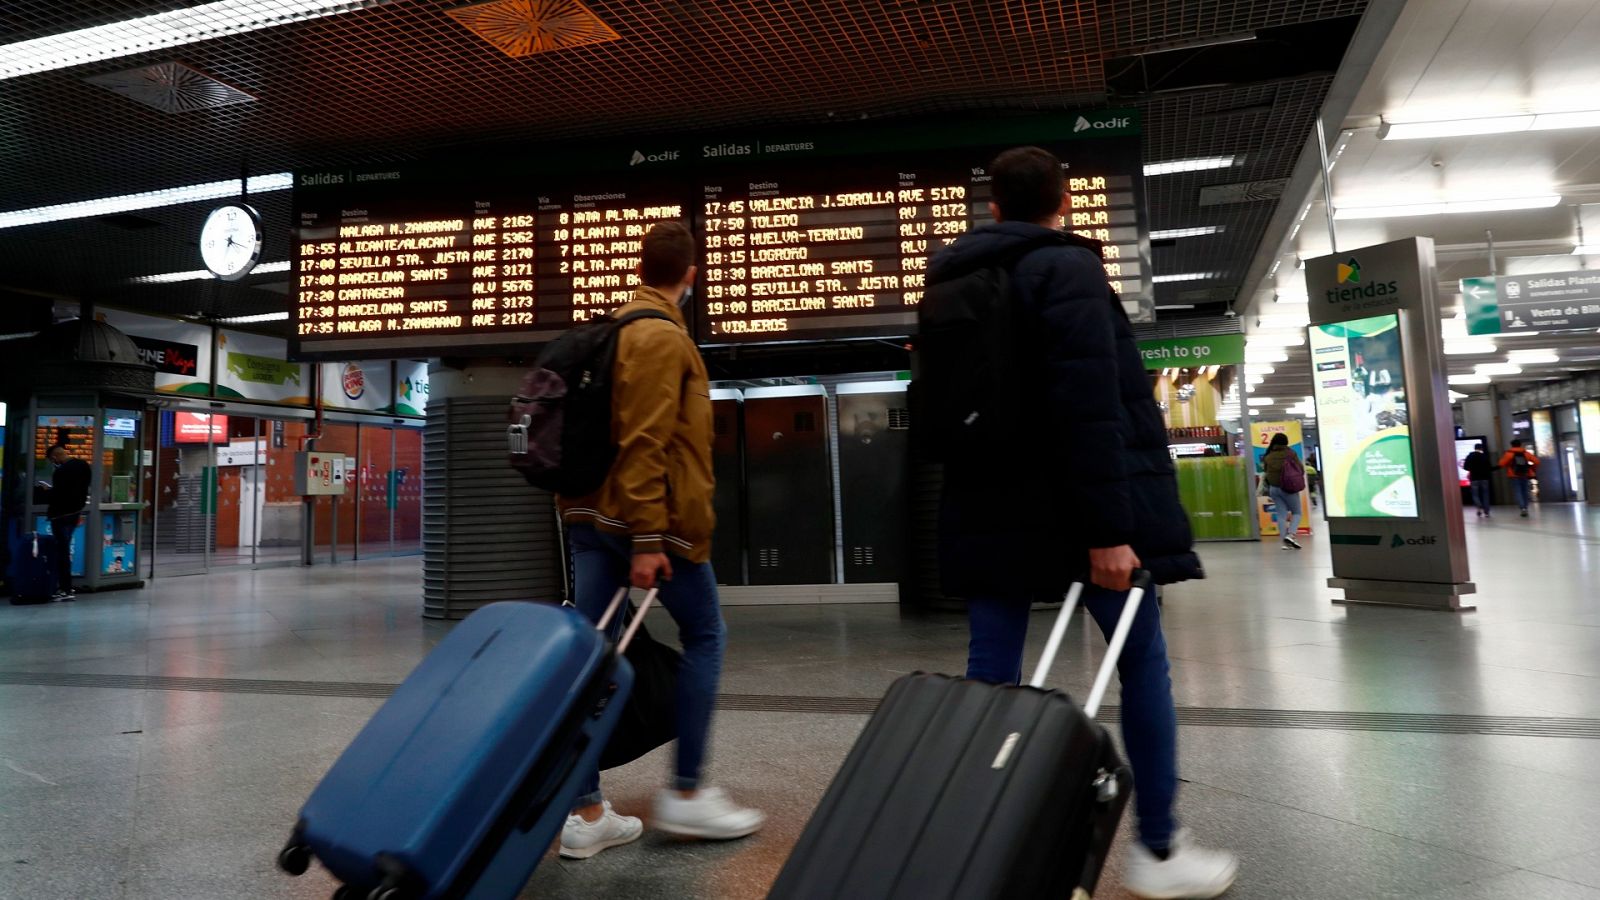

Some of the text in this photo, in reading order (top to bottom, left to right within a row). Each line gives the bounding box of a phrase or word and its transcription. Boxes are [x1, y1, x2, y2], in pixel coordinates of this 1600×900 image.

[1093, 117, 1131, 129] adif
[647, 151, 680, 162] adif
[703, 142, 815, 158] Salidas DEPARTURES
[301, 171, 401, 186] Salidas DEPARTURES
[898, 172, 916, 180] Tren
[704, 185, 722, 193] Hora
[749, 182, 779, 190] Destino
[1070, 177, 1106, 191] BAJA
[573, 192, 626, 202] Observaciones
[898, 186, 966, 202] AVE 5170
[1071, 194, 1107, 208] BAJA
[705, 201, 744, 215] 17:45
[749, 191, 894, 212] VALENCIA J.SOROLLA
[899, 203, 967, 220] AV 8172
[1072, 211, 1109, 226] BAJA
[473, 215, 533, 230] AVE 2162
[705, 217, 745, 232] 17:50
[750, 214, 798, 229] TOLEDO
[900, 220, 967, 237] ALV 2384
[473, 231, 533, 246] AVE 5362
[554, 230, 569, 242] 10
[573, 226, 620, 240] PLANTA
[750, 226, 863, 246] HUELVA-TERMINO
[706, 234, 745, 248] 18:05
[901, 239, 927, 253] ALV
[300, 243, 336, 256] 16:55
[473, 248, 533, 262] AVE 2170
[560, 245, 569, 256] 7
[300, 259, 336, 271] 17:00
[339, 251, 470, 269] SEVILLA STA. JUSTA
[706, 251, 745, 265] 18:15
[901, 257, 928, 270] AVE
[472, 263, 533, 278] AVE 3171
[559, 262, 569, 273] 2
[706, 267, 746, 282] 18:30
[751, 260, 873, 279] BARCELONA SANTS
[300, 274, 335, 287] 17:00
[339, 268, 448, 285] BARCELONA SANTS
[573, 275, 620, 289] PLANTA
[903, 273, 926, 288] AVE
[1528, 278, 1566, 289] Salidas
[472, 280, 533, 294] ALV 5676
[707, 284, 747, 298] 19:00
[751, 276, 899, 296] SEVILLA STA. JUSTA
[1326, 280, 1398, 304] tiendas
[299, 290, 335, 303] 17:20
[338, 287, 405, 301] CARTAGENA
[338, 300, 447, 317] BARCELONA SANTS
[472, 296, 533, 310] AVE 3173
[707, 301, 747, 315] 19:00
[752, 294, 874, 313] BARCELONA SANTS
[298, 306, 334, 319] 17:30
[472, 312, 533, 326] AVE 2172
[1530, 308, 1562, 317] Venta
[1564, 307, 1579, 315] de
[298, 322, 335, 335] 17:35
[722, 318, 788, 334] VIAJEROS
[1139, 345, 1211, 359] resh to go
[1406, 536, 1438, 546] adif
